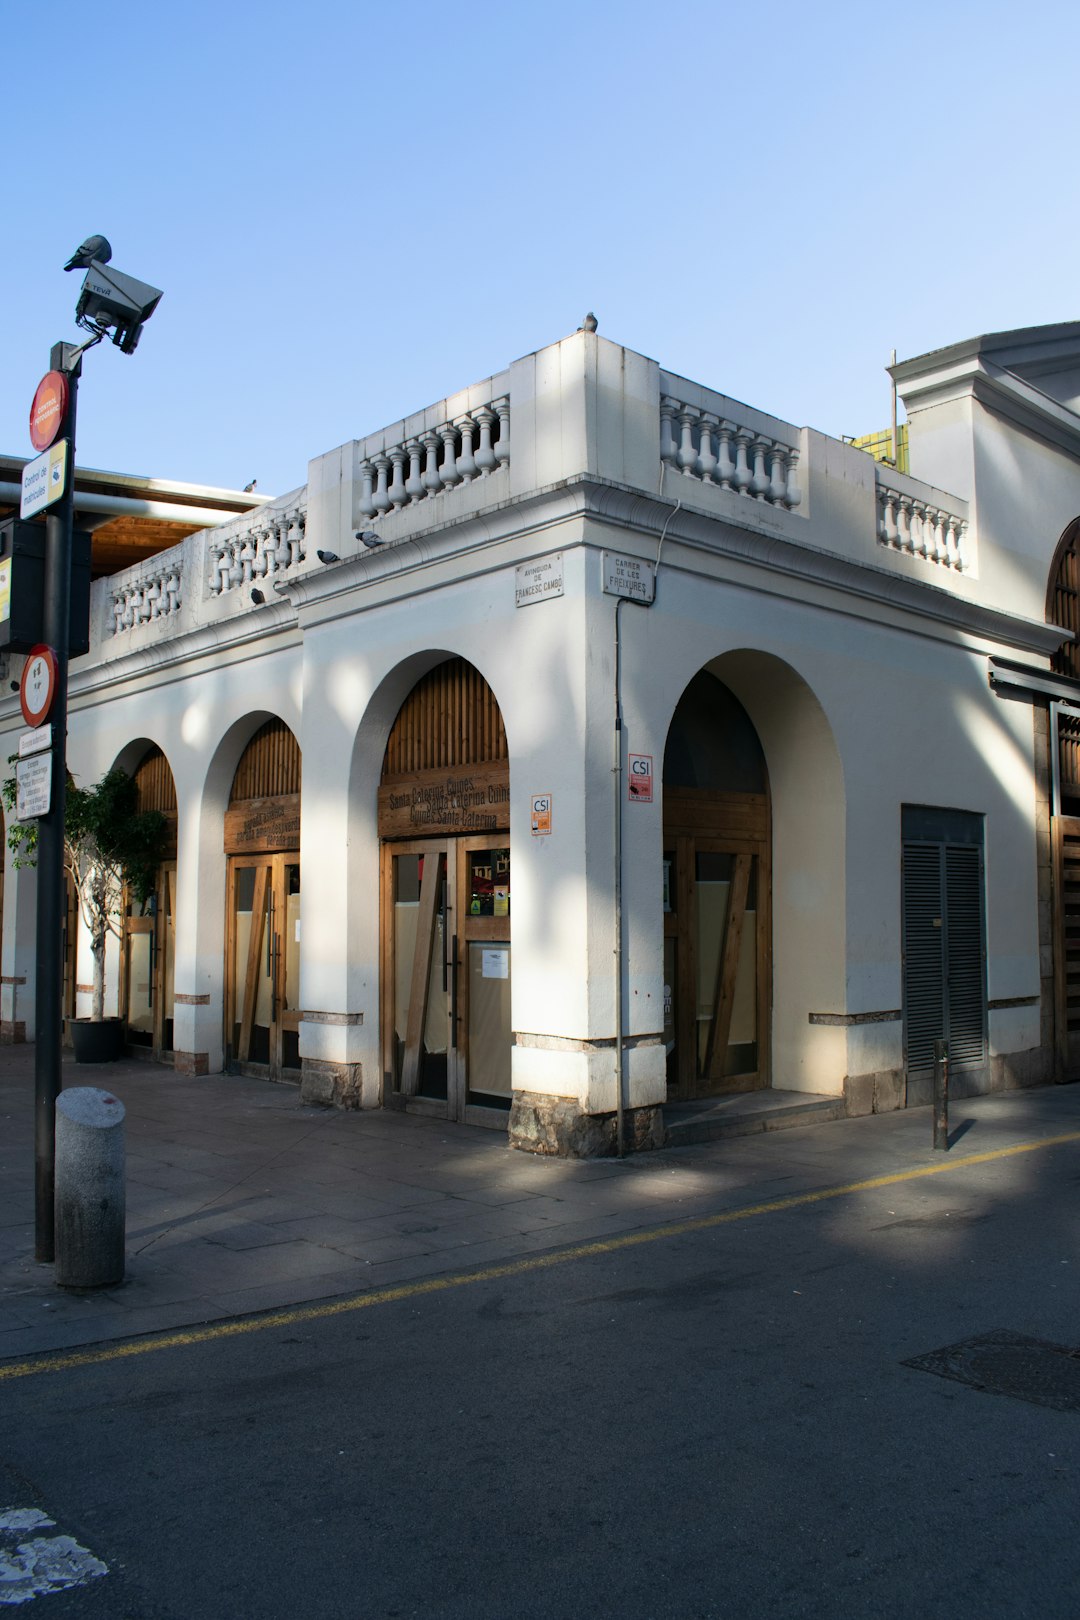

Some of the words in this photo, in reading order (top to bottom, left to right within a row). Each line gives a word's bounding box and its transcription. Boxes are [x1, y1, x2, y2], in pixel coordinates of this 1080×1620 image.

[25, 471, 40, 488] Control
[524, 563, 552, 577] AVINGUDA
[615, 559, 640, 571] CARRER
[533, 574, 542, 582] DE
[616, 567, 625, 576] DE
[627, 571, 640, 580] LES
[515, 583, 542, 600] FRANCESC
[609, 576, 646, 592] FREIXURES
[632, 760, 649, 775] CSI
[389, 793, 410, 811] Santa
[412, 784, 444, 805] Caterina
[488, 785, 510, 804] Cuine
[534, 799, 549, 812] CSI
